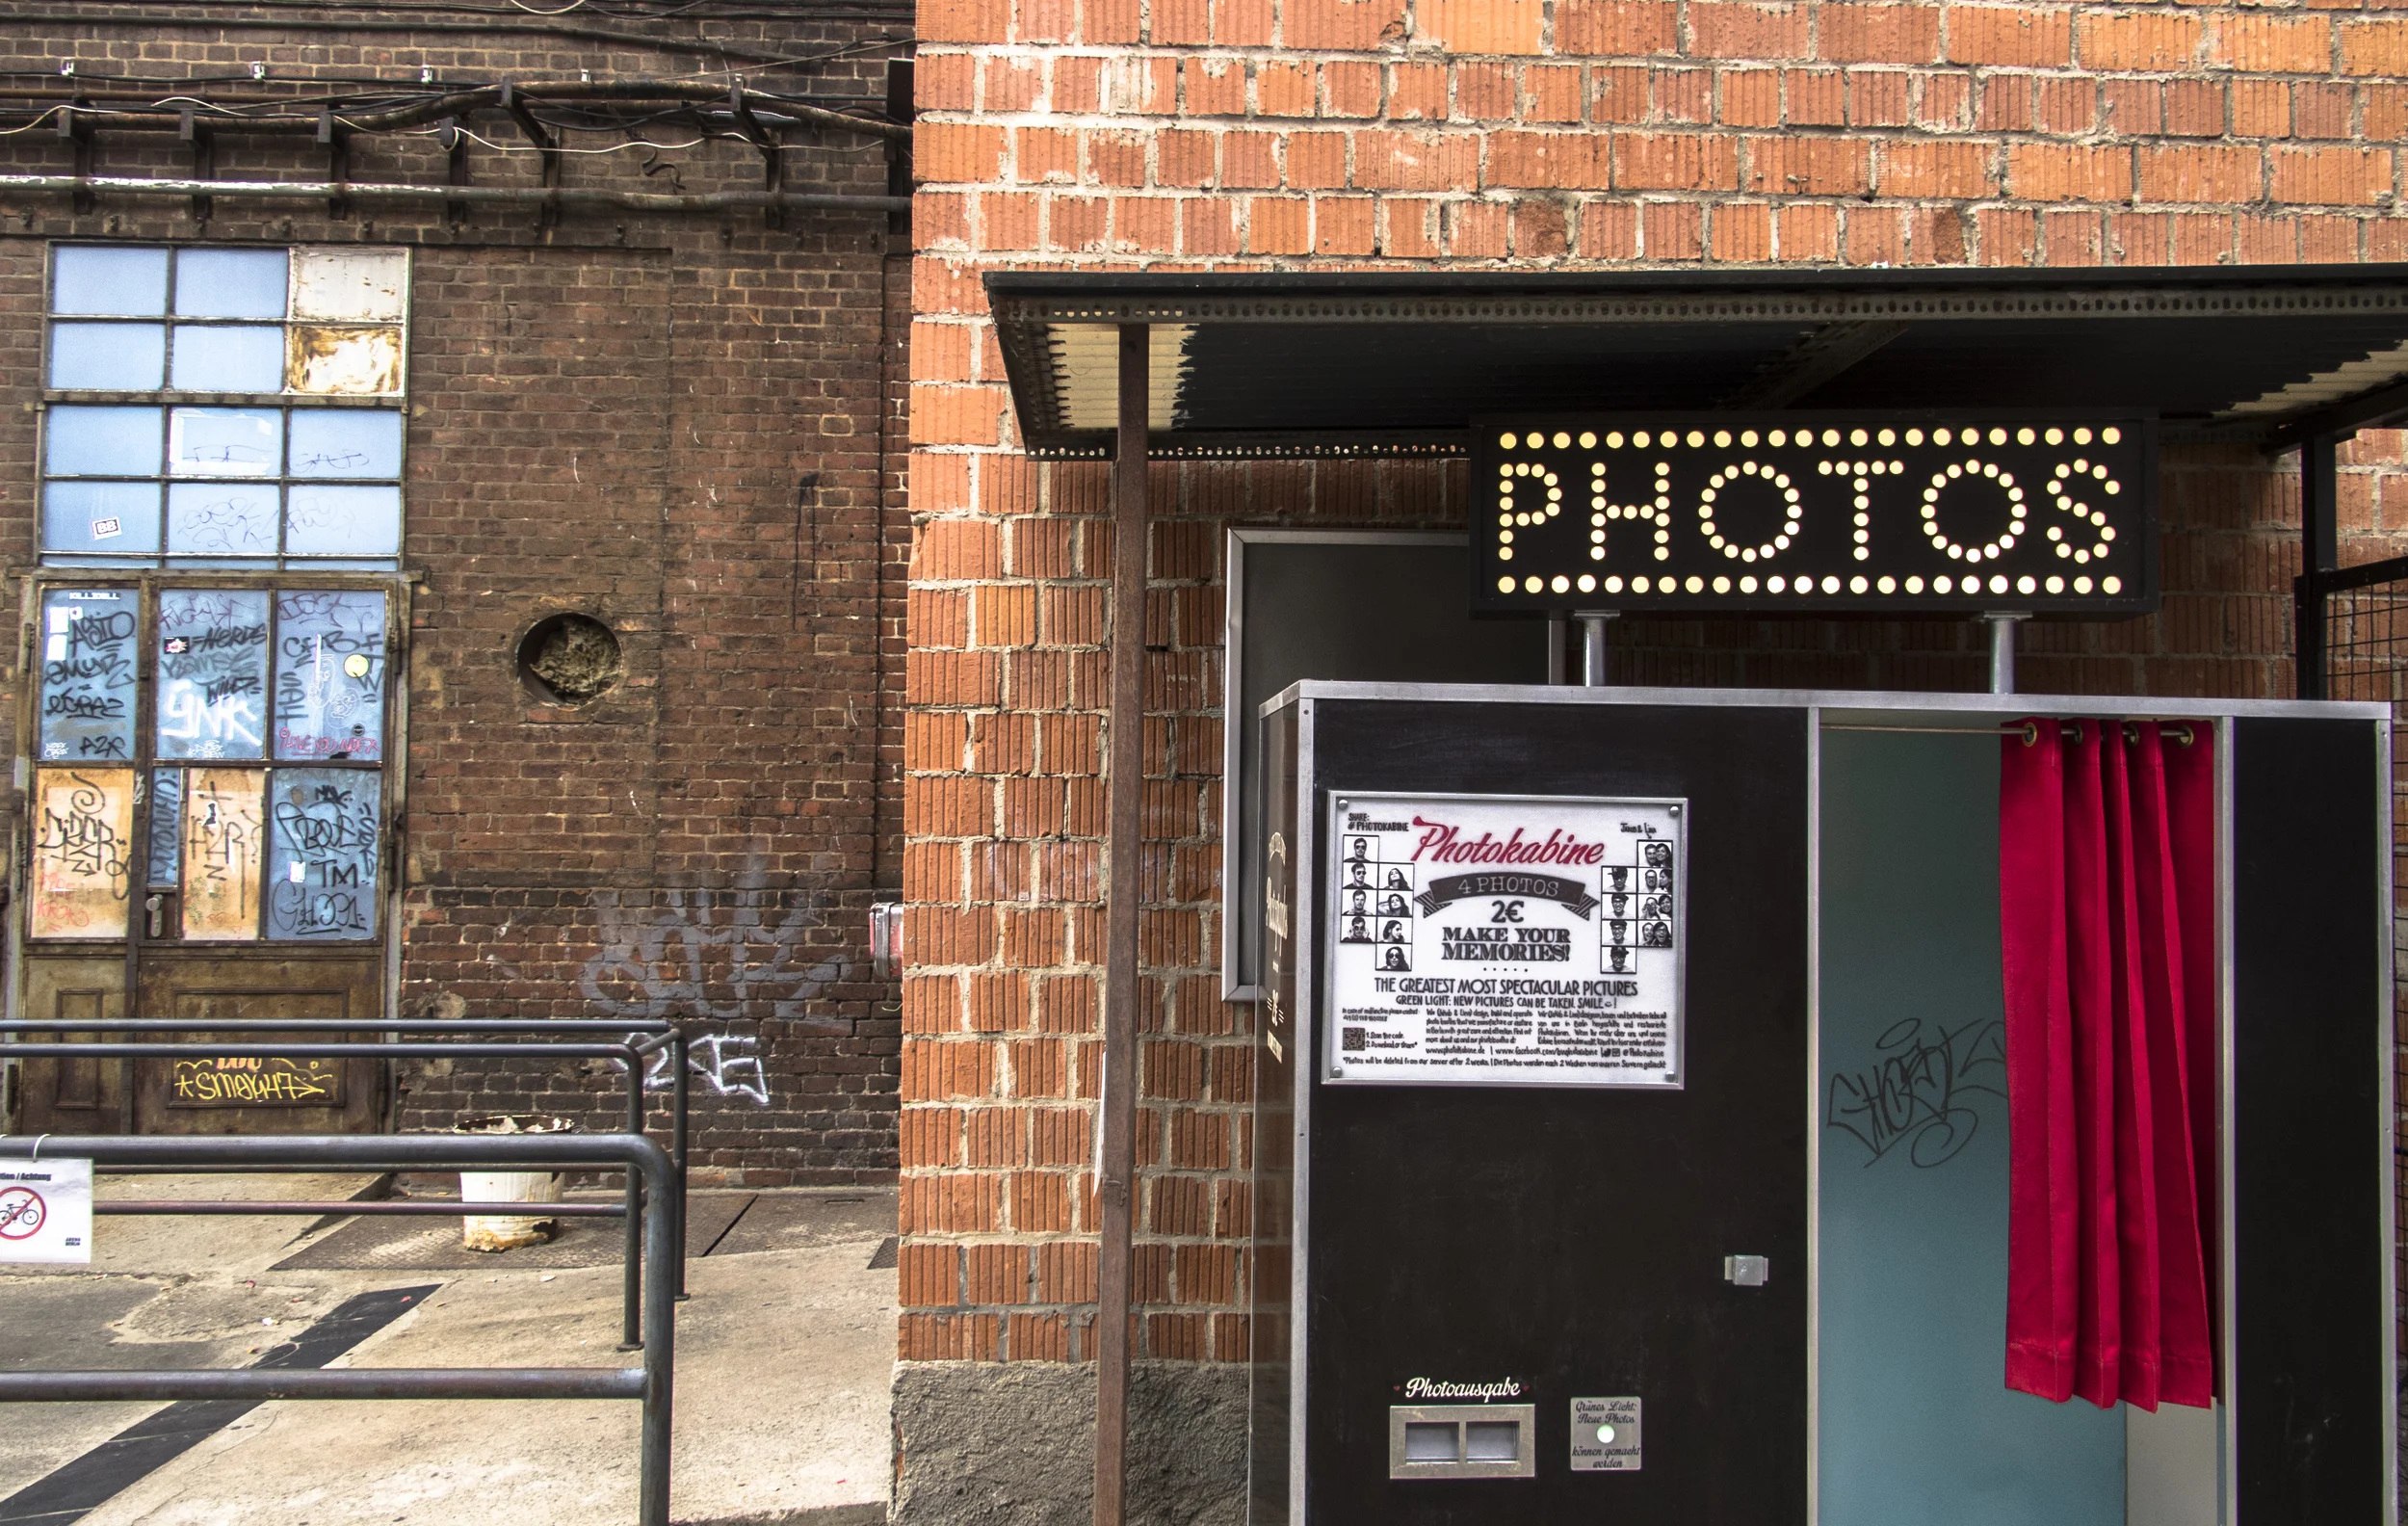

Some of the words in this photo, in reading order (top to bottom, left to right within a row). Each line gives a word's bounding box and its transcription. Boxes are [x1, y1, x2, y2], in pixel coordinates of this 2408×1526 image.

[1499, 458, 2121, 565] PHOTOS
[1356, 822, 1410, 832] PHOTOKABINE
[1410, 816, 1605, 865] Photokabine
[1458, 879, 1472, 895] 4
[1477, 876, 1559, 897] PHOTOS
[1491, 900, 1525, 923] 2€
[1442, 927, 1508, 942] MAKE
[1514, 928, 1571, 943] YOUR
[1441, 942, 1571, 962] MEMORIES!
[1374, 977, 1396, 993] THE
[1399, 977, 1455, 994] GREATEST
[1457, 979, 1497, 994] MOST
[1499, 979, 1581, 996] SPECTACULAR
[1583, 980, 1638, 997] PICTURES
[1396, 995, 1423, 1006] GREEN
[1426, 995, 1452, 1007] LIGHT:
[1453, 996, 1474, 1007] NEW
[1476, 996, 1514, 1008] PICTURES
[1516, 997, 1533, 1008] CAN
[1535, 997, 1546, 1008] BE
[1578, 997, 1604, 1010] SMILE
[1405, 1377, 1521, 1403] Photoausgabe
[1575, 1400, 1606, 1413] Grünes
[1577, 1412, 1603, 1425] Neue
[1604, 1412, 1636, 1425] Photos
[1571, 1445, 1603, 1458] können
[1605, 1444, 1641, 1460] gemacht
[1592, 1458, 1624, 1469] werden
